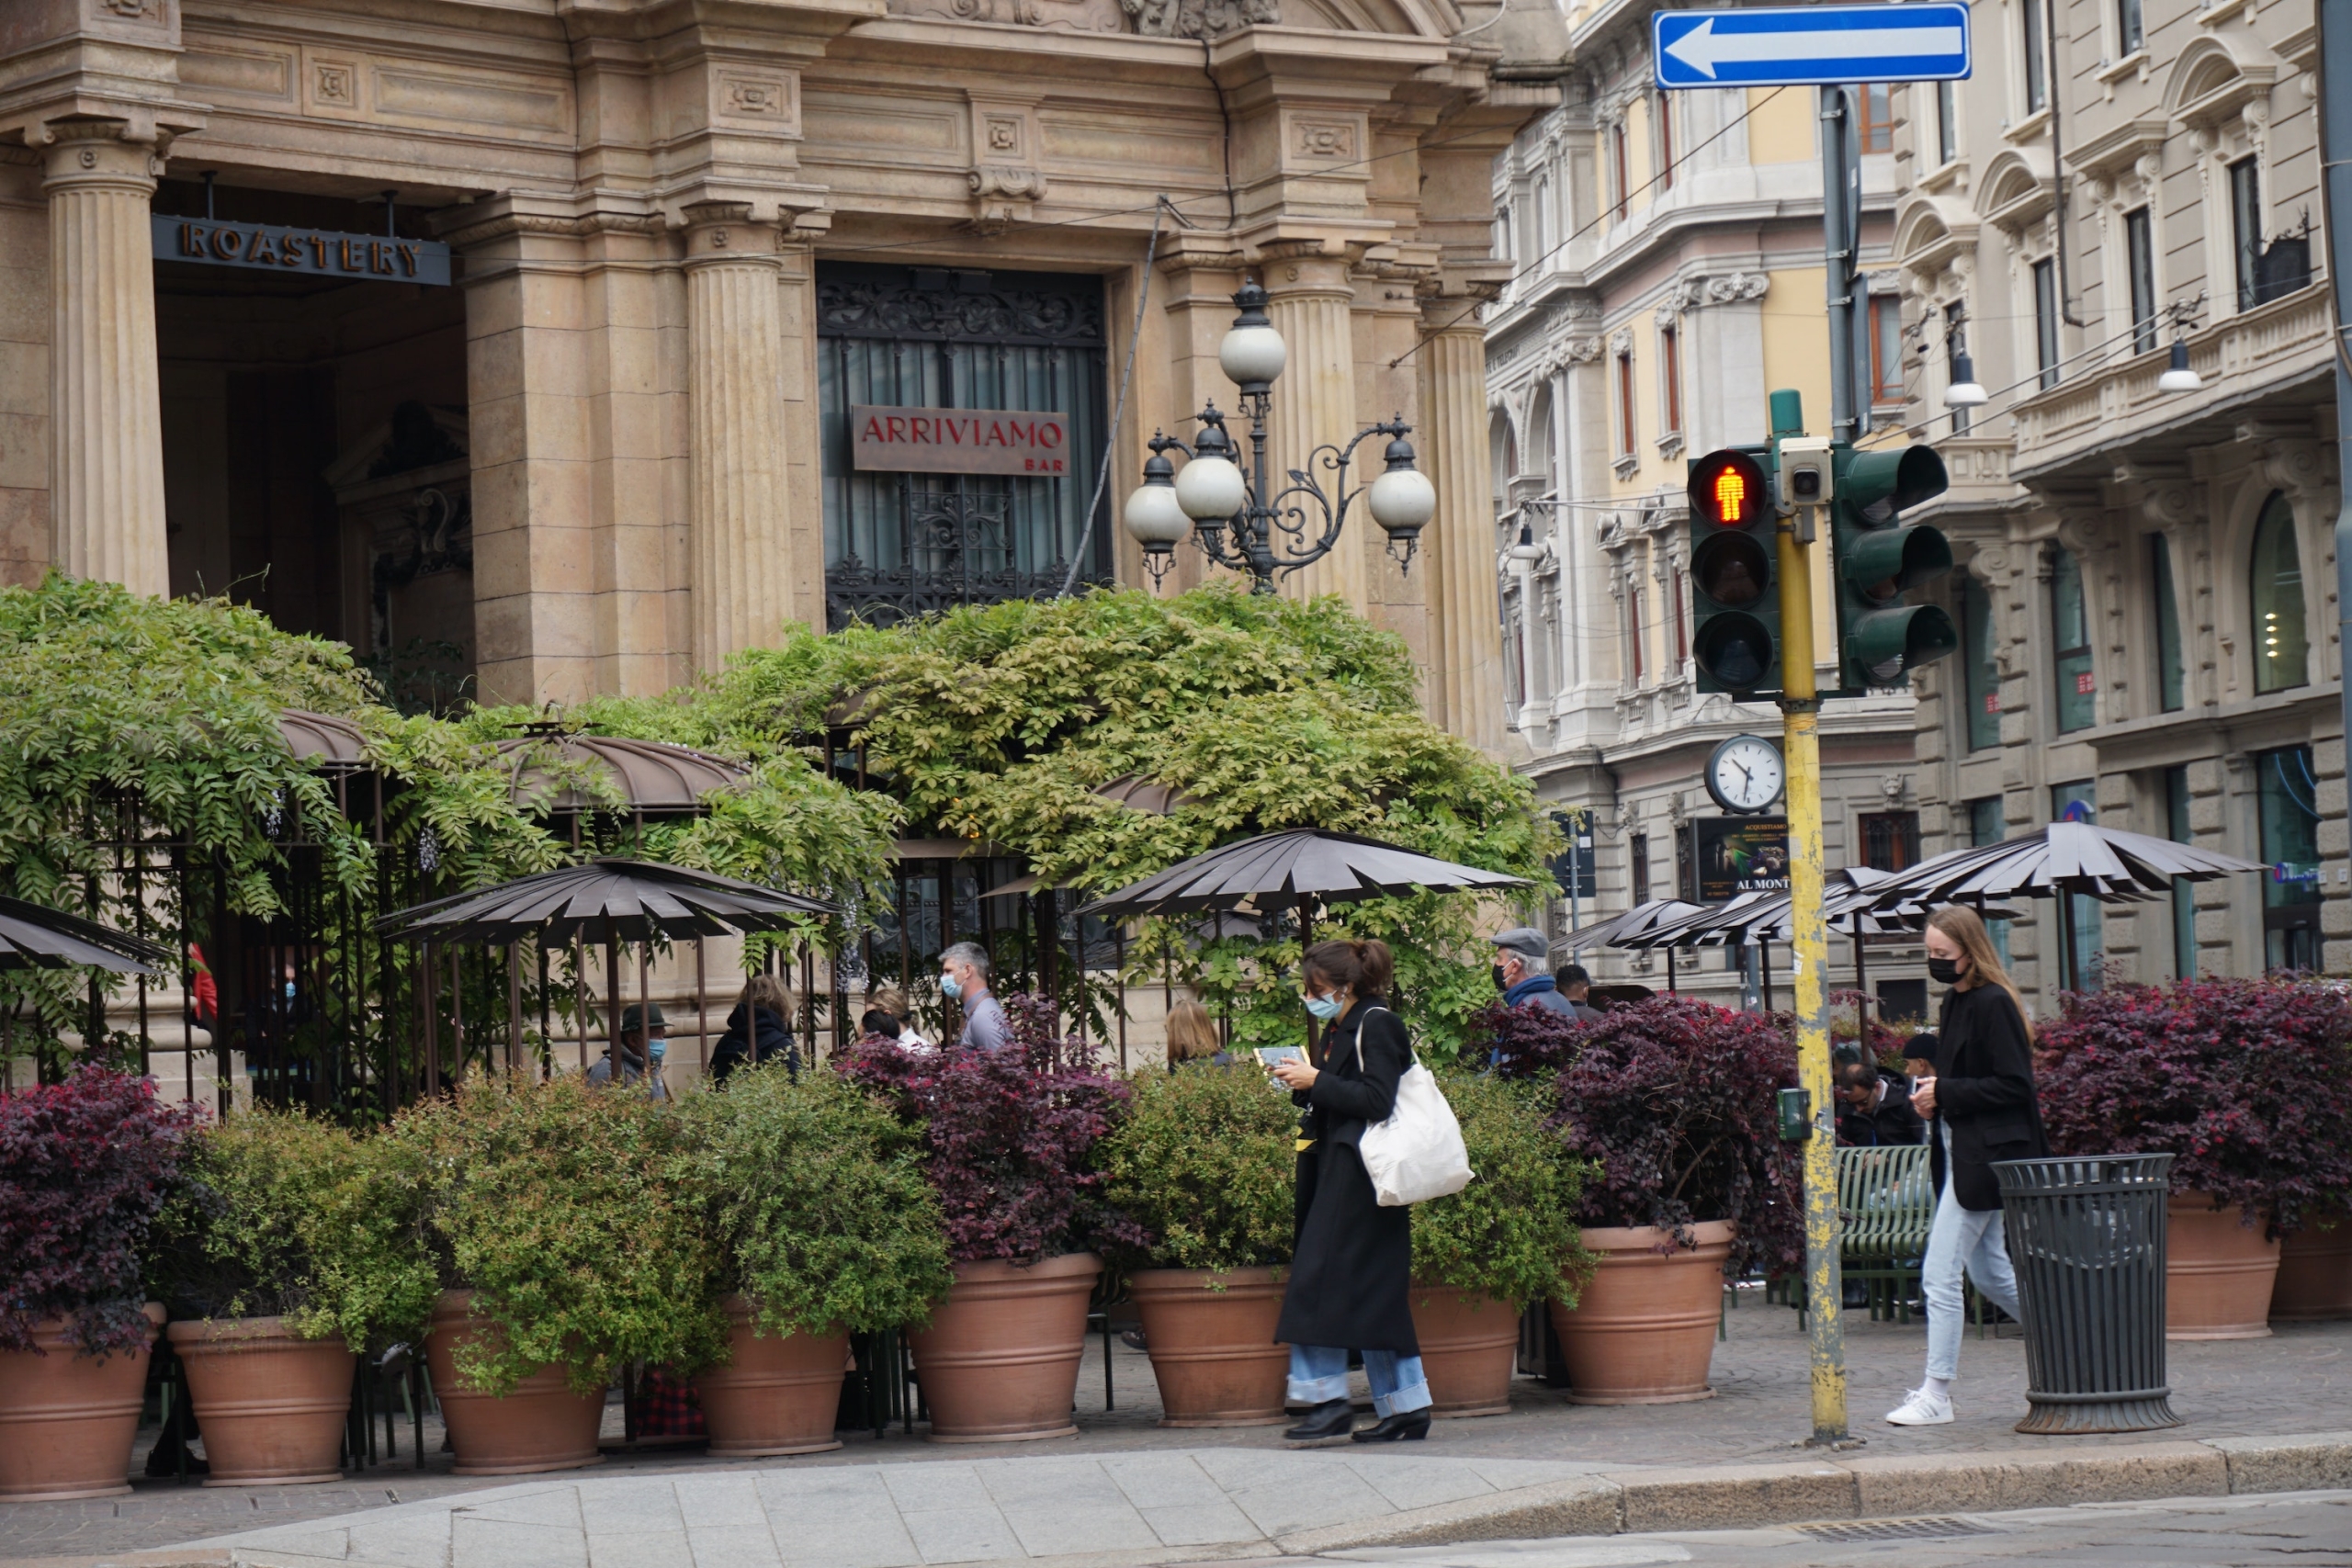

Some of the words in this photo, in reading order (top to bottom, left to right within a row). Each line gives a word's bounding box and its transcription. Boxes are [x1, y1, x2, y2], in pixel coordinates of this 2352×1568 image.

[181, 222, 423, 276] ROASTERY
[862, 415, 1063, 448] ARRIVIAMO
[1024, 458, 1063, 471] BAR
[1736, 880, 1753, 890] AL
[1755, 878, 1791, 889] MONT
